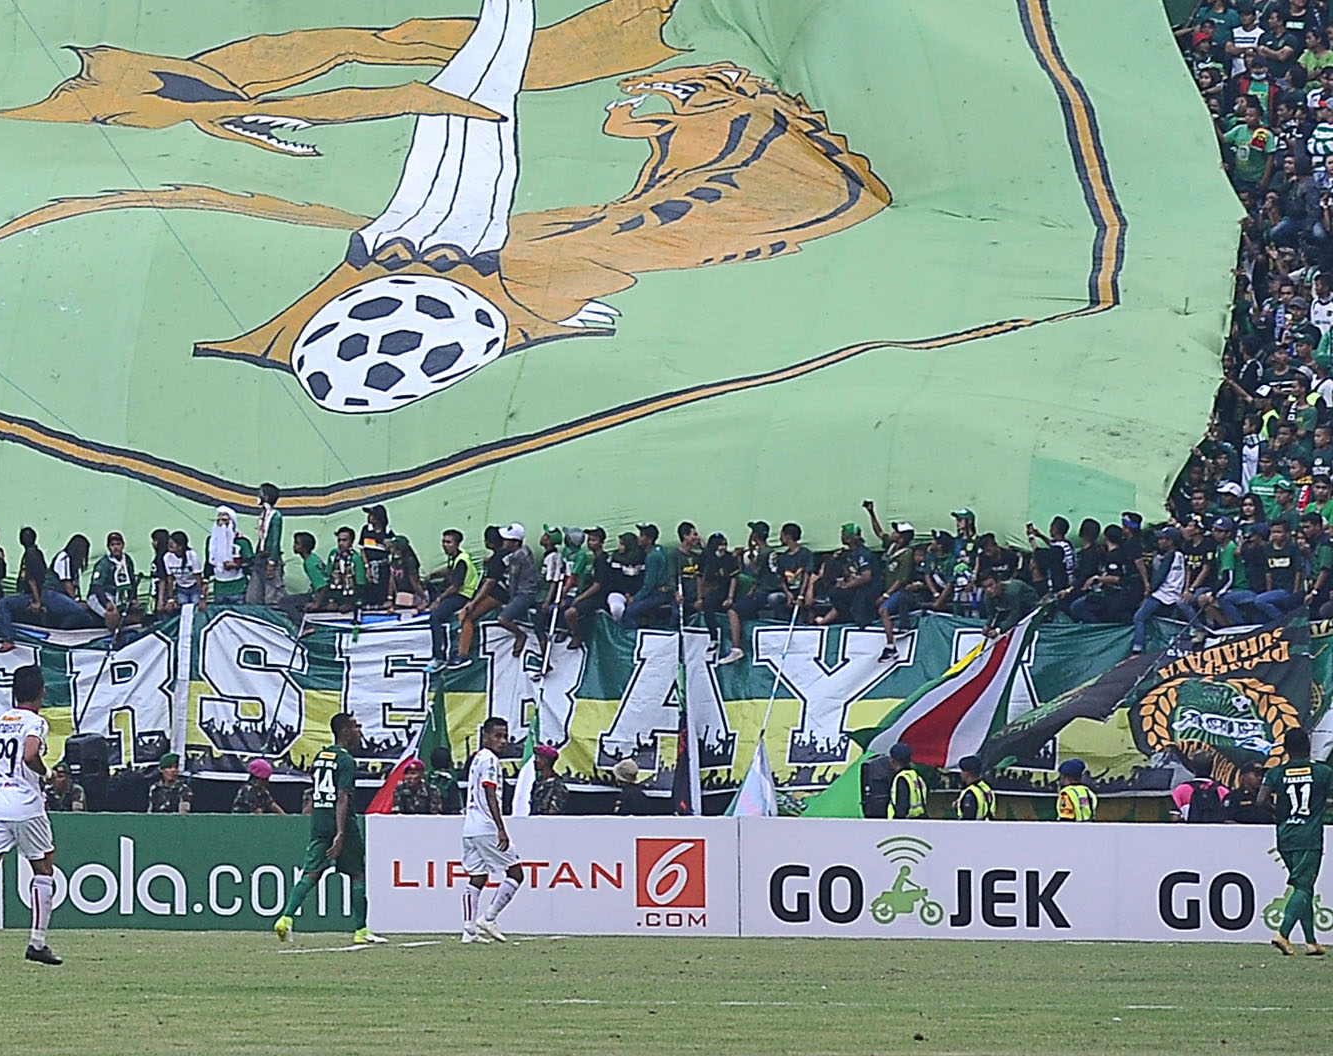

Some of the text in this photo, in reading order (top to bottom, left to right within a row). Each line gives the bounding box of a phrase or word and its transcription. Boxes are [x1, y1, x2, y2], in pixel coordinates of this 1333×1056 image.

[312, 767, 336, 801] 14
[1285, 783, 1312, 817] 11
[768, 863, 1072, 929] GO JEK
[1157, 869, 1257, 931] GO
